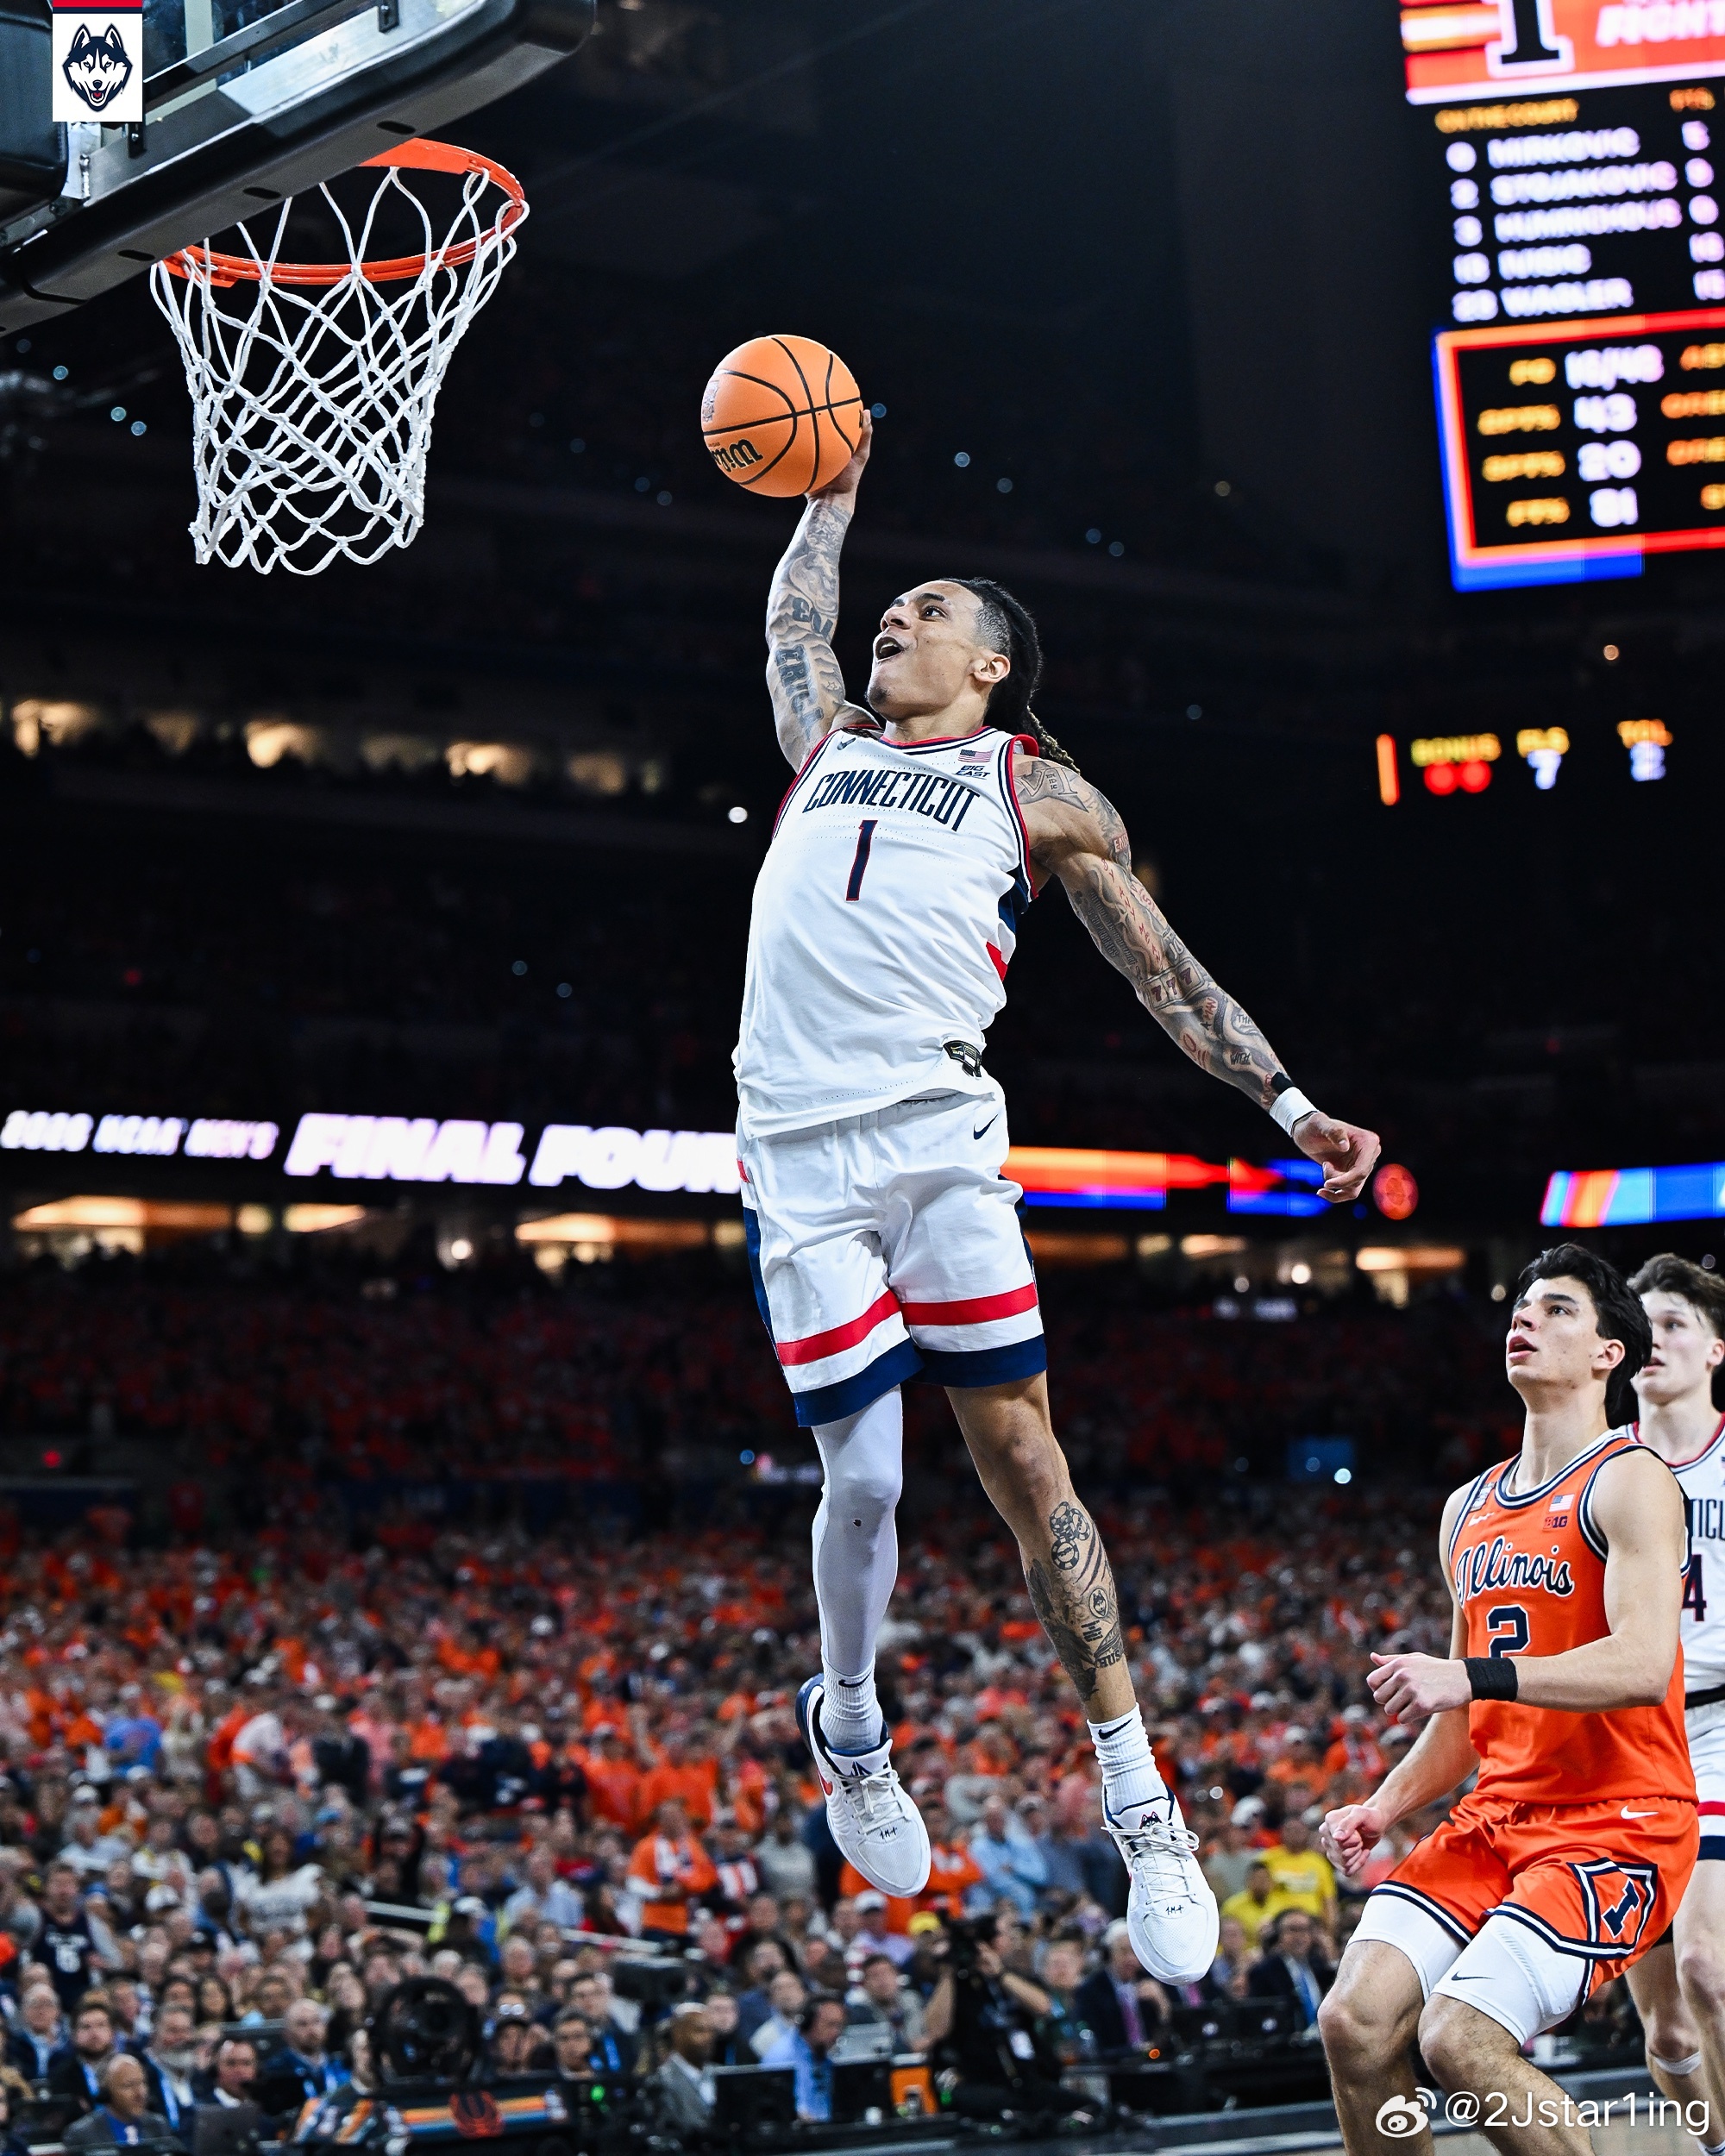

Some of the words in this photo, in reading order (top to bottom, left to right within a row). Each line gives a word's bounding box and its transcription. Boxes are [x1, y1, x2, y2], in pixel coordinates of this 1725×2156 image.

[802, 769, 980, 832] CONNECTICUT
[845, 819, 878, 901] 1
[284, 1112, 526, 1186] FINAL
[1455, 1535, 1575, 1606] Illinois
[1486, 1604, 1530, 1658] 2
